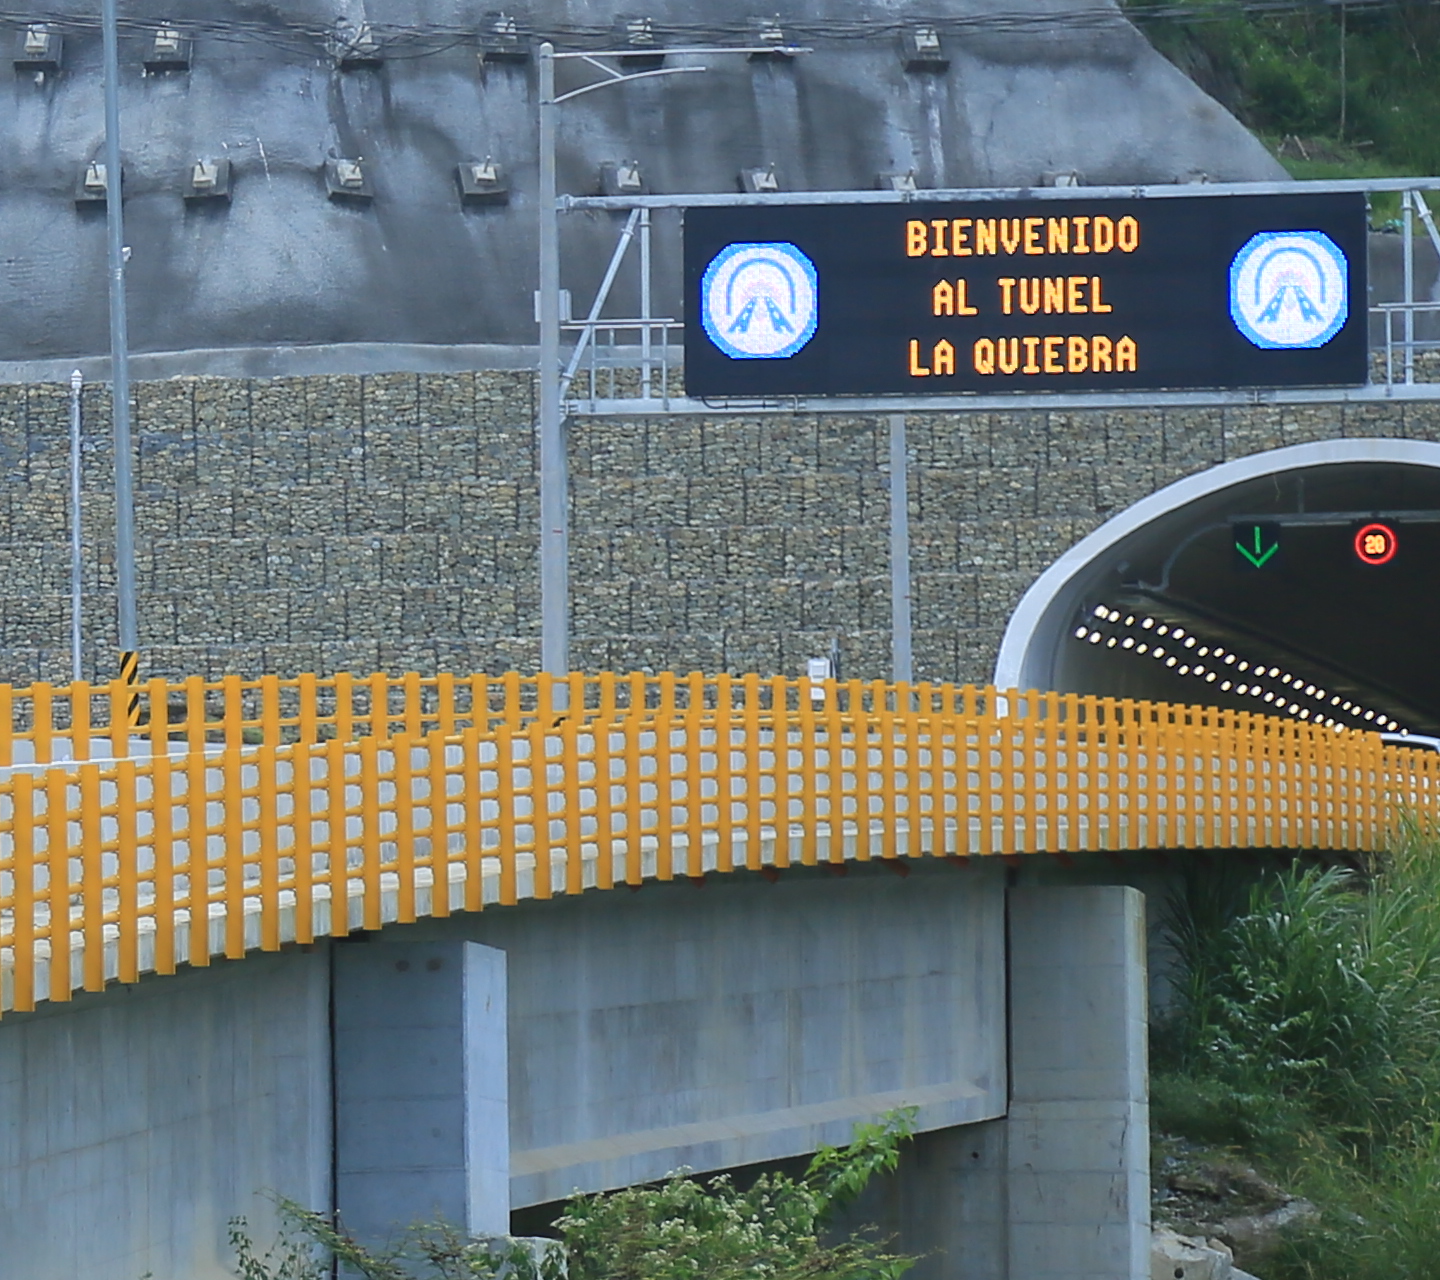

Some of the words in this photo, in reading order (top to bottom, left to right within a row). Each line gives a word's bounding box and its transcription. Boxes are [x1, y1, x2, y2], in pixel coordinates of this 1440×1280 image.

[906, 216, 1139, 257] BIENVENIDO
[932, 279, 978, 316] AL
[997, 276, 1113, 315] TUNEL
[909, 339, 955, 377] LA
[974, 335, 1137, 375] QUIEBRA
[1364, 534, 1386, 555] 20
